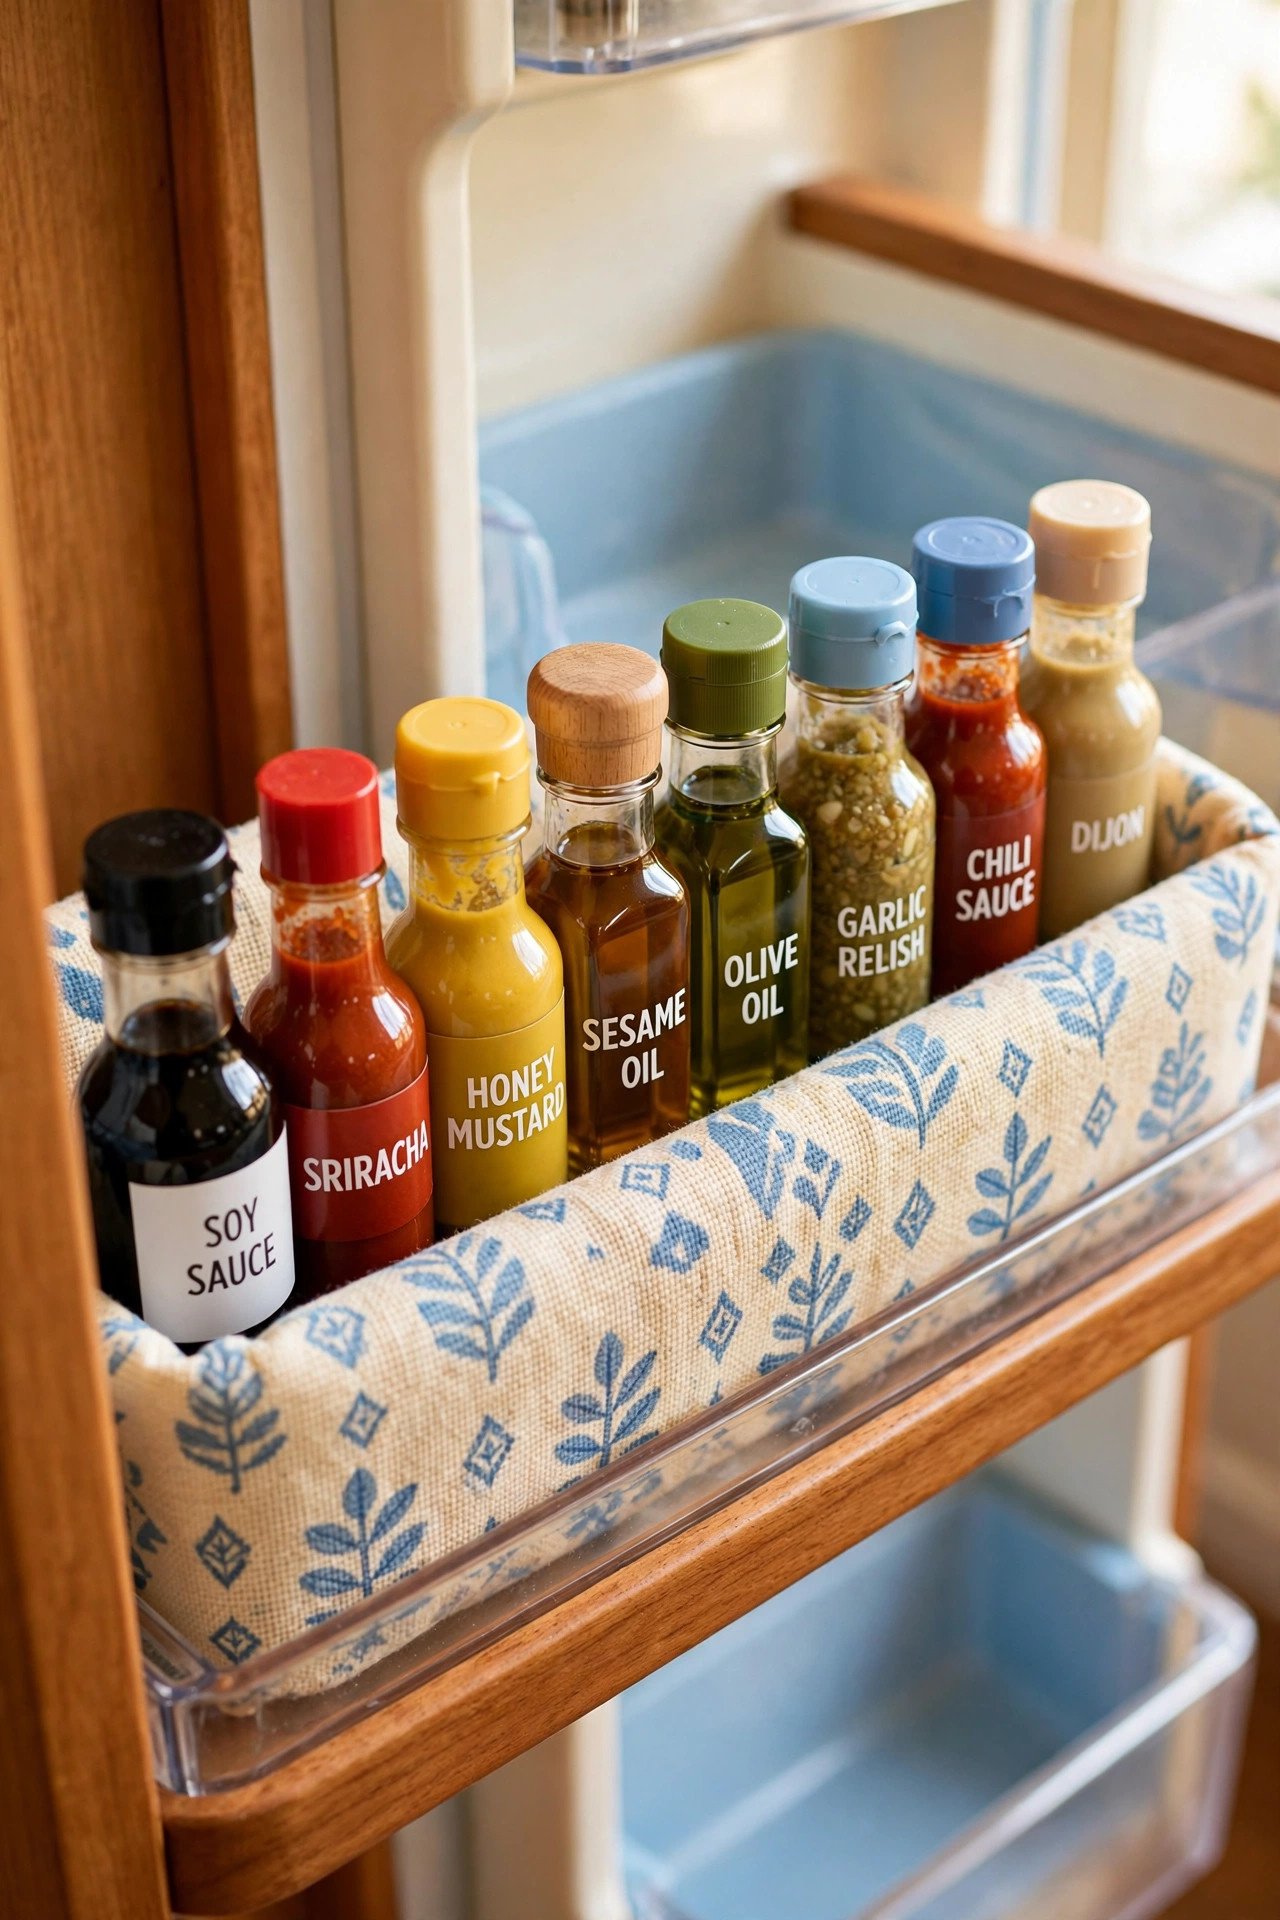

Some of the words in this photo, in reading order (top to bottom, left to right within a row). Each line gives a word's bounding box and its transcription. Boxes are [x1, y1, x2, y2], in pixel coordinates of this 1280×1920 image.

[1071, 805, 1144, 853] DIJON
[967, 835, 1032, 881] CHILI
[837, 885, 927, 939] GARLIC
[956, 870, 1035, 922] SAUCE
[724, 933, 799, 988] OLIVE
[838, 923, 925, 978] RELISH
[582, 988, 686, 1052] SESAME
[742, 986, 784, 1025] OIL
[467, 1046, 555, 1109] HONEY
[621, 1048, 664, 1089] OIL
[448, 1080, 565, 1150] MUSTARD
[304, 1120, 429, 1192] SRIRACHA
[204, 1197, 258, 1248] SOY
[187, 1232, 277, 1296] SAUCE
